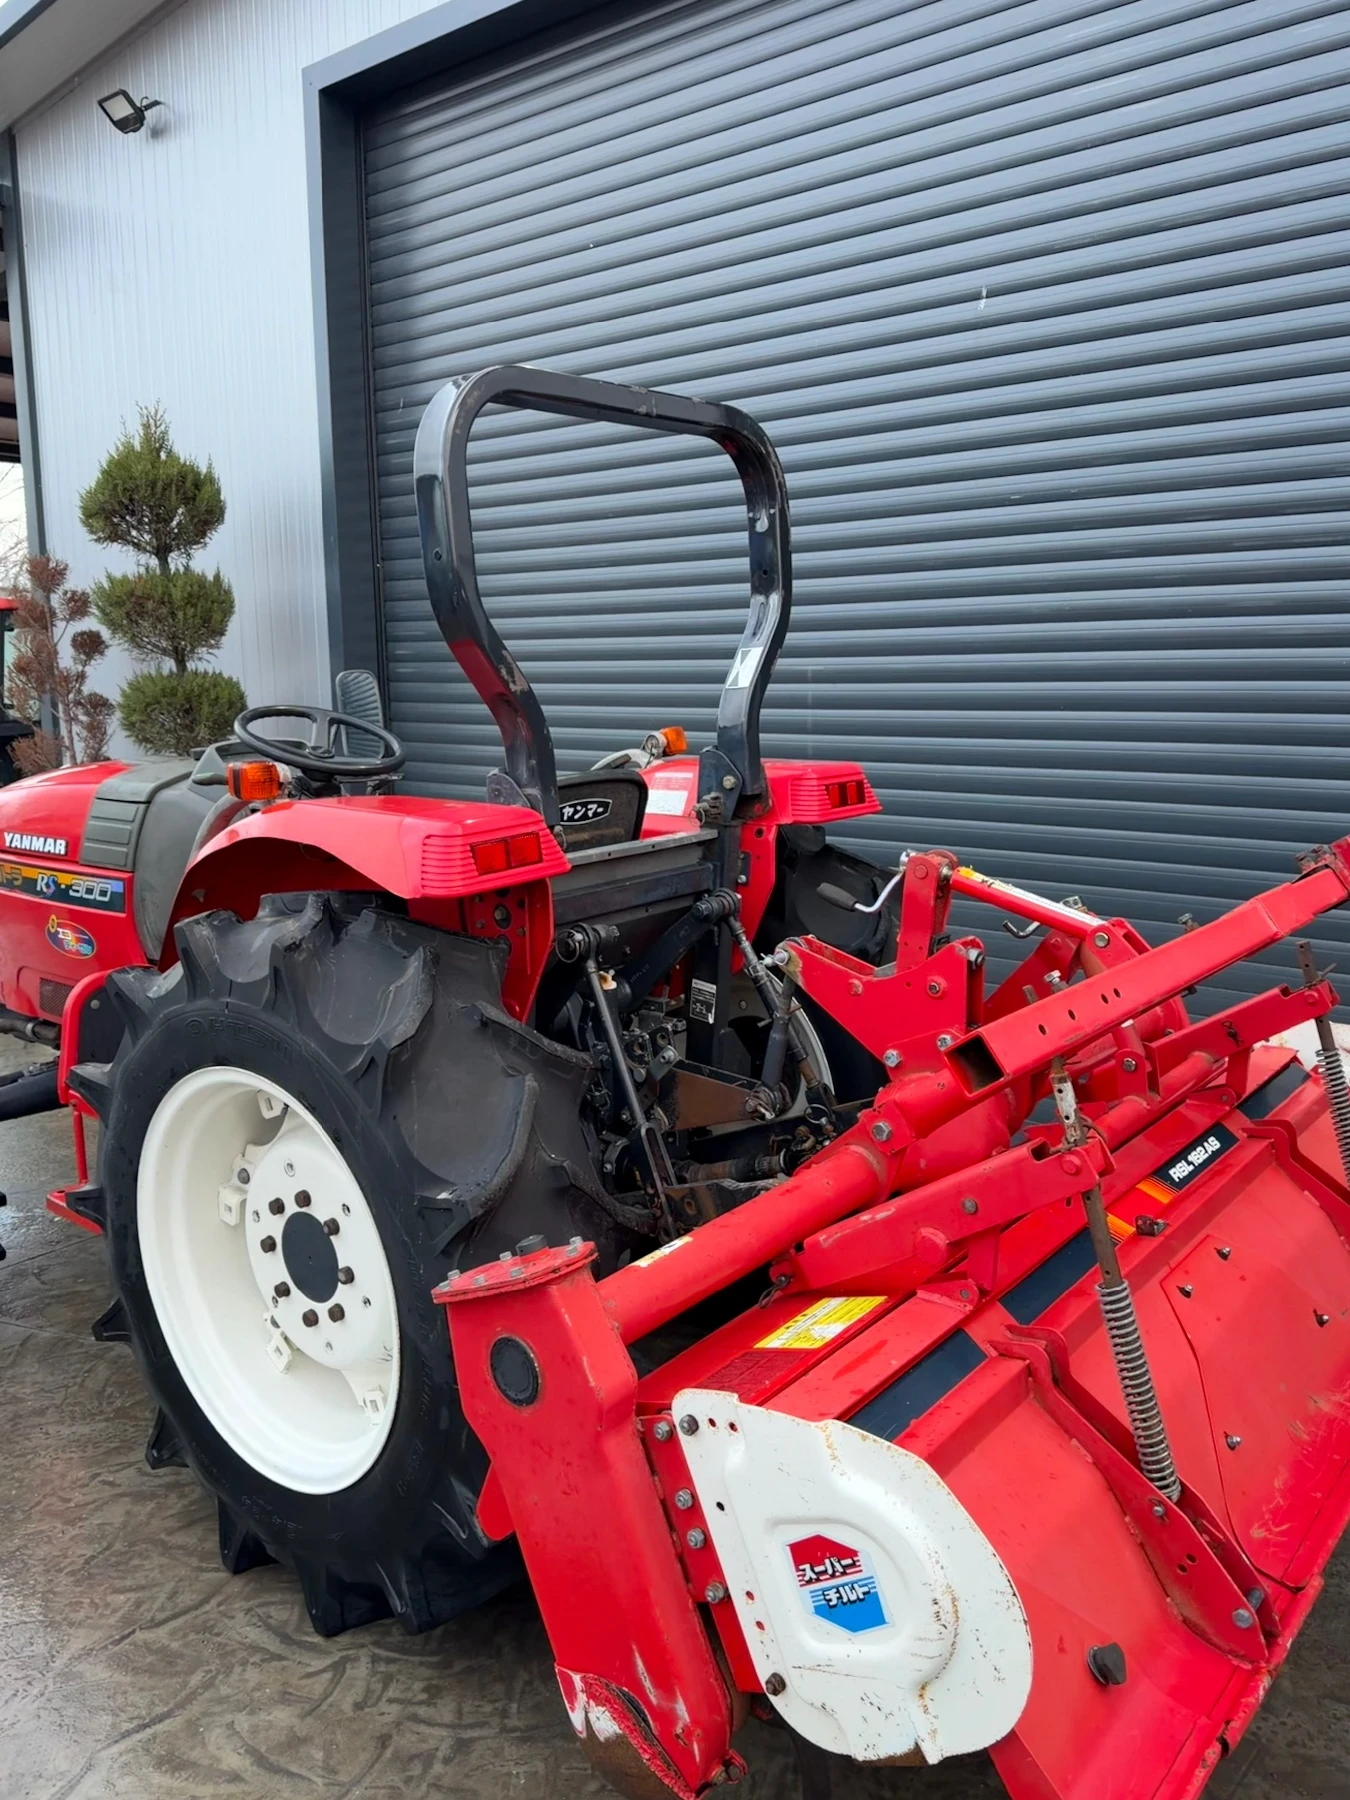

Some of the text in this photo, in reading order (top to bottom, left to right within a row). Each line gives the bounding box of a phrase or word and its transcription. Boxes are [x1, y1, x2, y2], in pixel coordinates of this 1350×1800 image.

[562, 803, 604, 821] ヤンマー
[3, 831, 67, 855] YANMAR
[798, 1556, 855, 1582] スーパー
[823, 1582, 871, 1607] チルト
